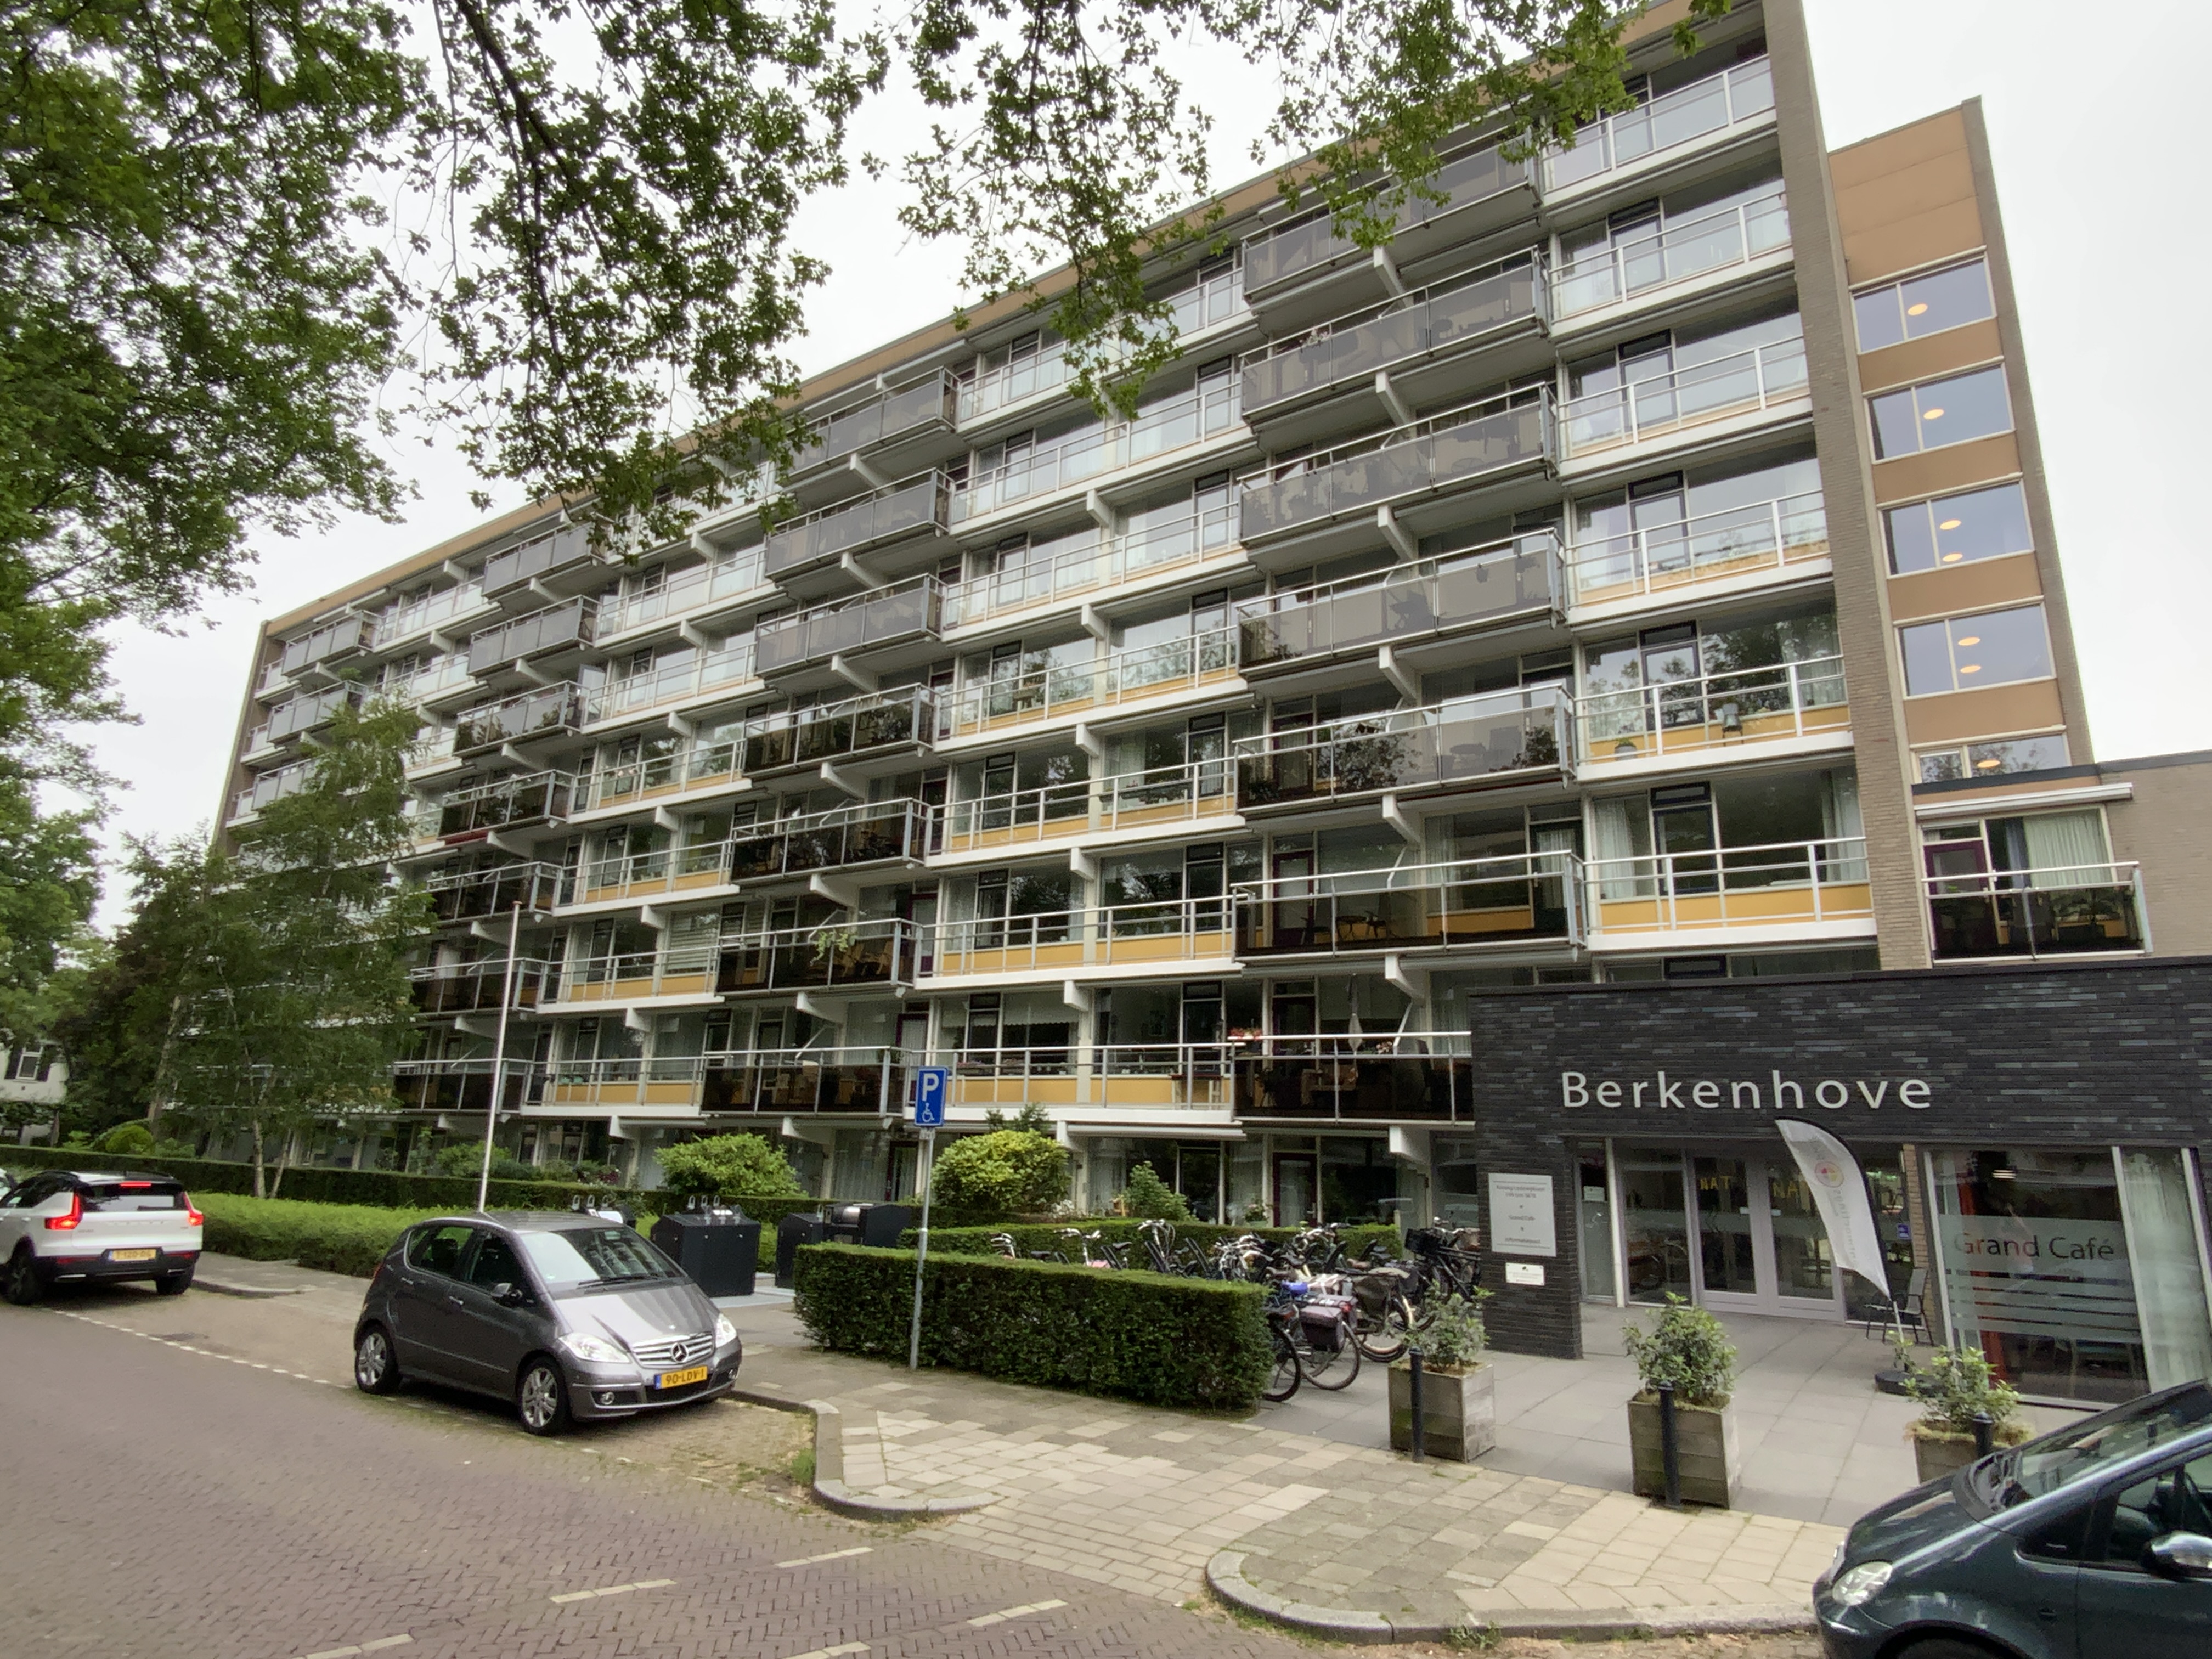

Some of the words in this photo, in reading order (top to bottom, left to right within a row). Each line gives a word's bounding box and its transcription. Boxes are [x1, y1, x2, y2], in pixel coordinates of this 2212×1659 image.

[922, 1073, 940, 1102] P
[1561, 1070, 1931, 1109] Berkenhove
[1700, 1175, 1733, 1190] NAT
[1954, 1232, 2040, 1257] Grand
[2050, 1236, 2114, 1261] Café
[665, 1368, 704, 1385] 90-LDV-1
